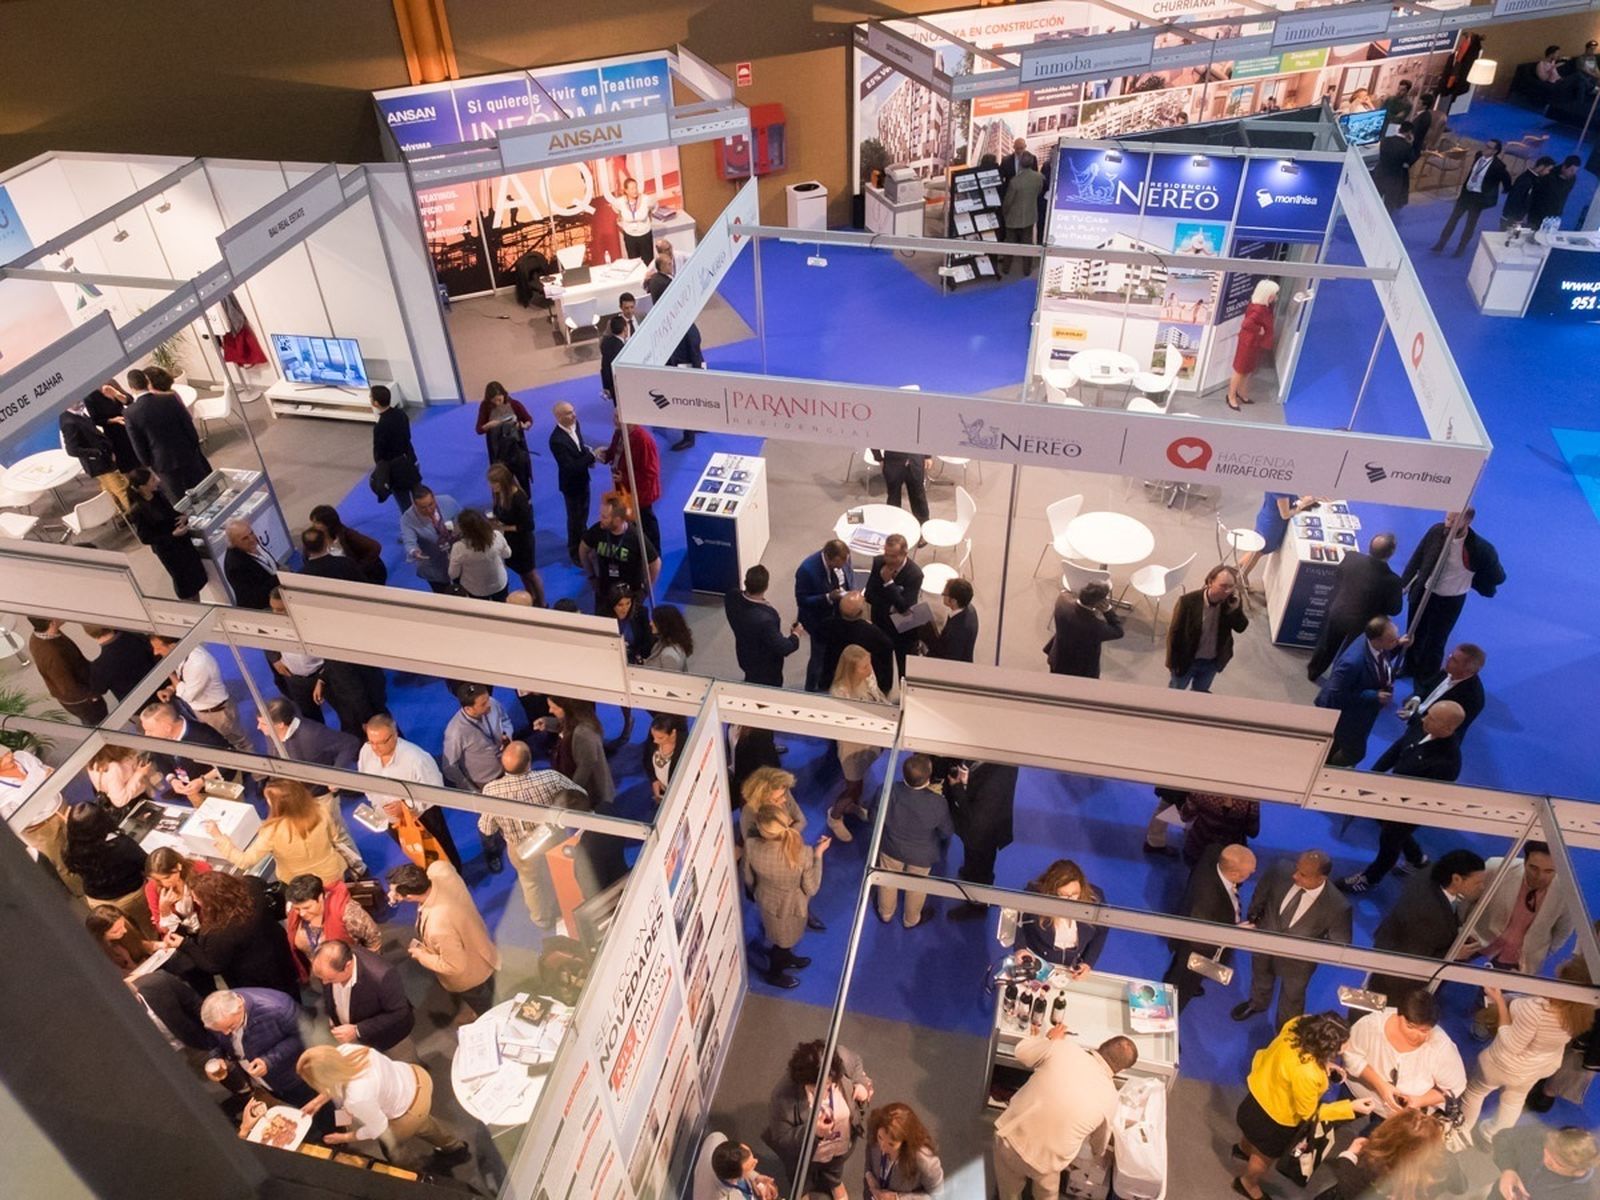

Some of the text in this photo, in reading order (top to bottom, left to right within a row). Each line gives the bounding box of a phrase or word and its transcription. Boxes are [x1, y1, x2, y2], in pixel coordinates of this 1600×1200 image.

[969, 23, 983, 37] EN
[985, 16, 1065, 35] CONSTRUCCIÓN
[1285, 22, 1336, 41] inmoba
[1034, 55, 1092, 76] inmoba
[467, 99, 482, 114] Si
[486, 93, 540, 113] quieres
[581, 84, 598, 97] en
[602, 75, 660, 94] Teatinos
[387, 106, 436, 124] ANSAN
[548, 123, 623, 151] ANSAN
[1115, 179, 1219, 211] NEREO
[1150, 181, 1218, 192] RESIDENCIAL
[1274, 193, 1318, 206] monthisa
[16, 394, 31, 410] DE
[33, 372, 64, 399] AZAHAR
[671, 396, 721, 410] monthisa
[732, 390, 872, 422] PARANINFO
[999, 432, 1083, 458] NEREO
[1217, 451, 1296, 469] HACIENDA
[1215, 463, 1294, 481] MIRAFLORES
[1390, 468, 1452, 485] monthisa
[597, 541, 629, 562] NIKE
[599, 903, 665, 1075] NOVEDADES
